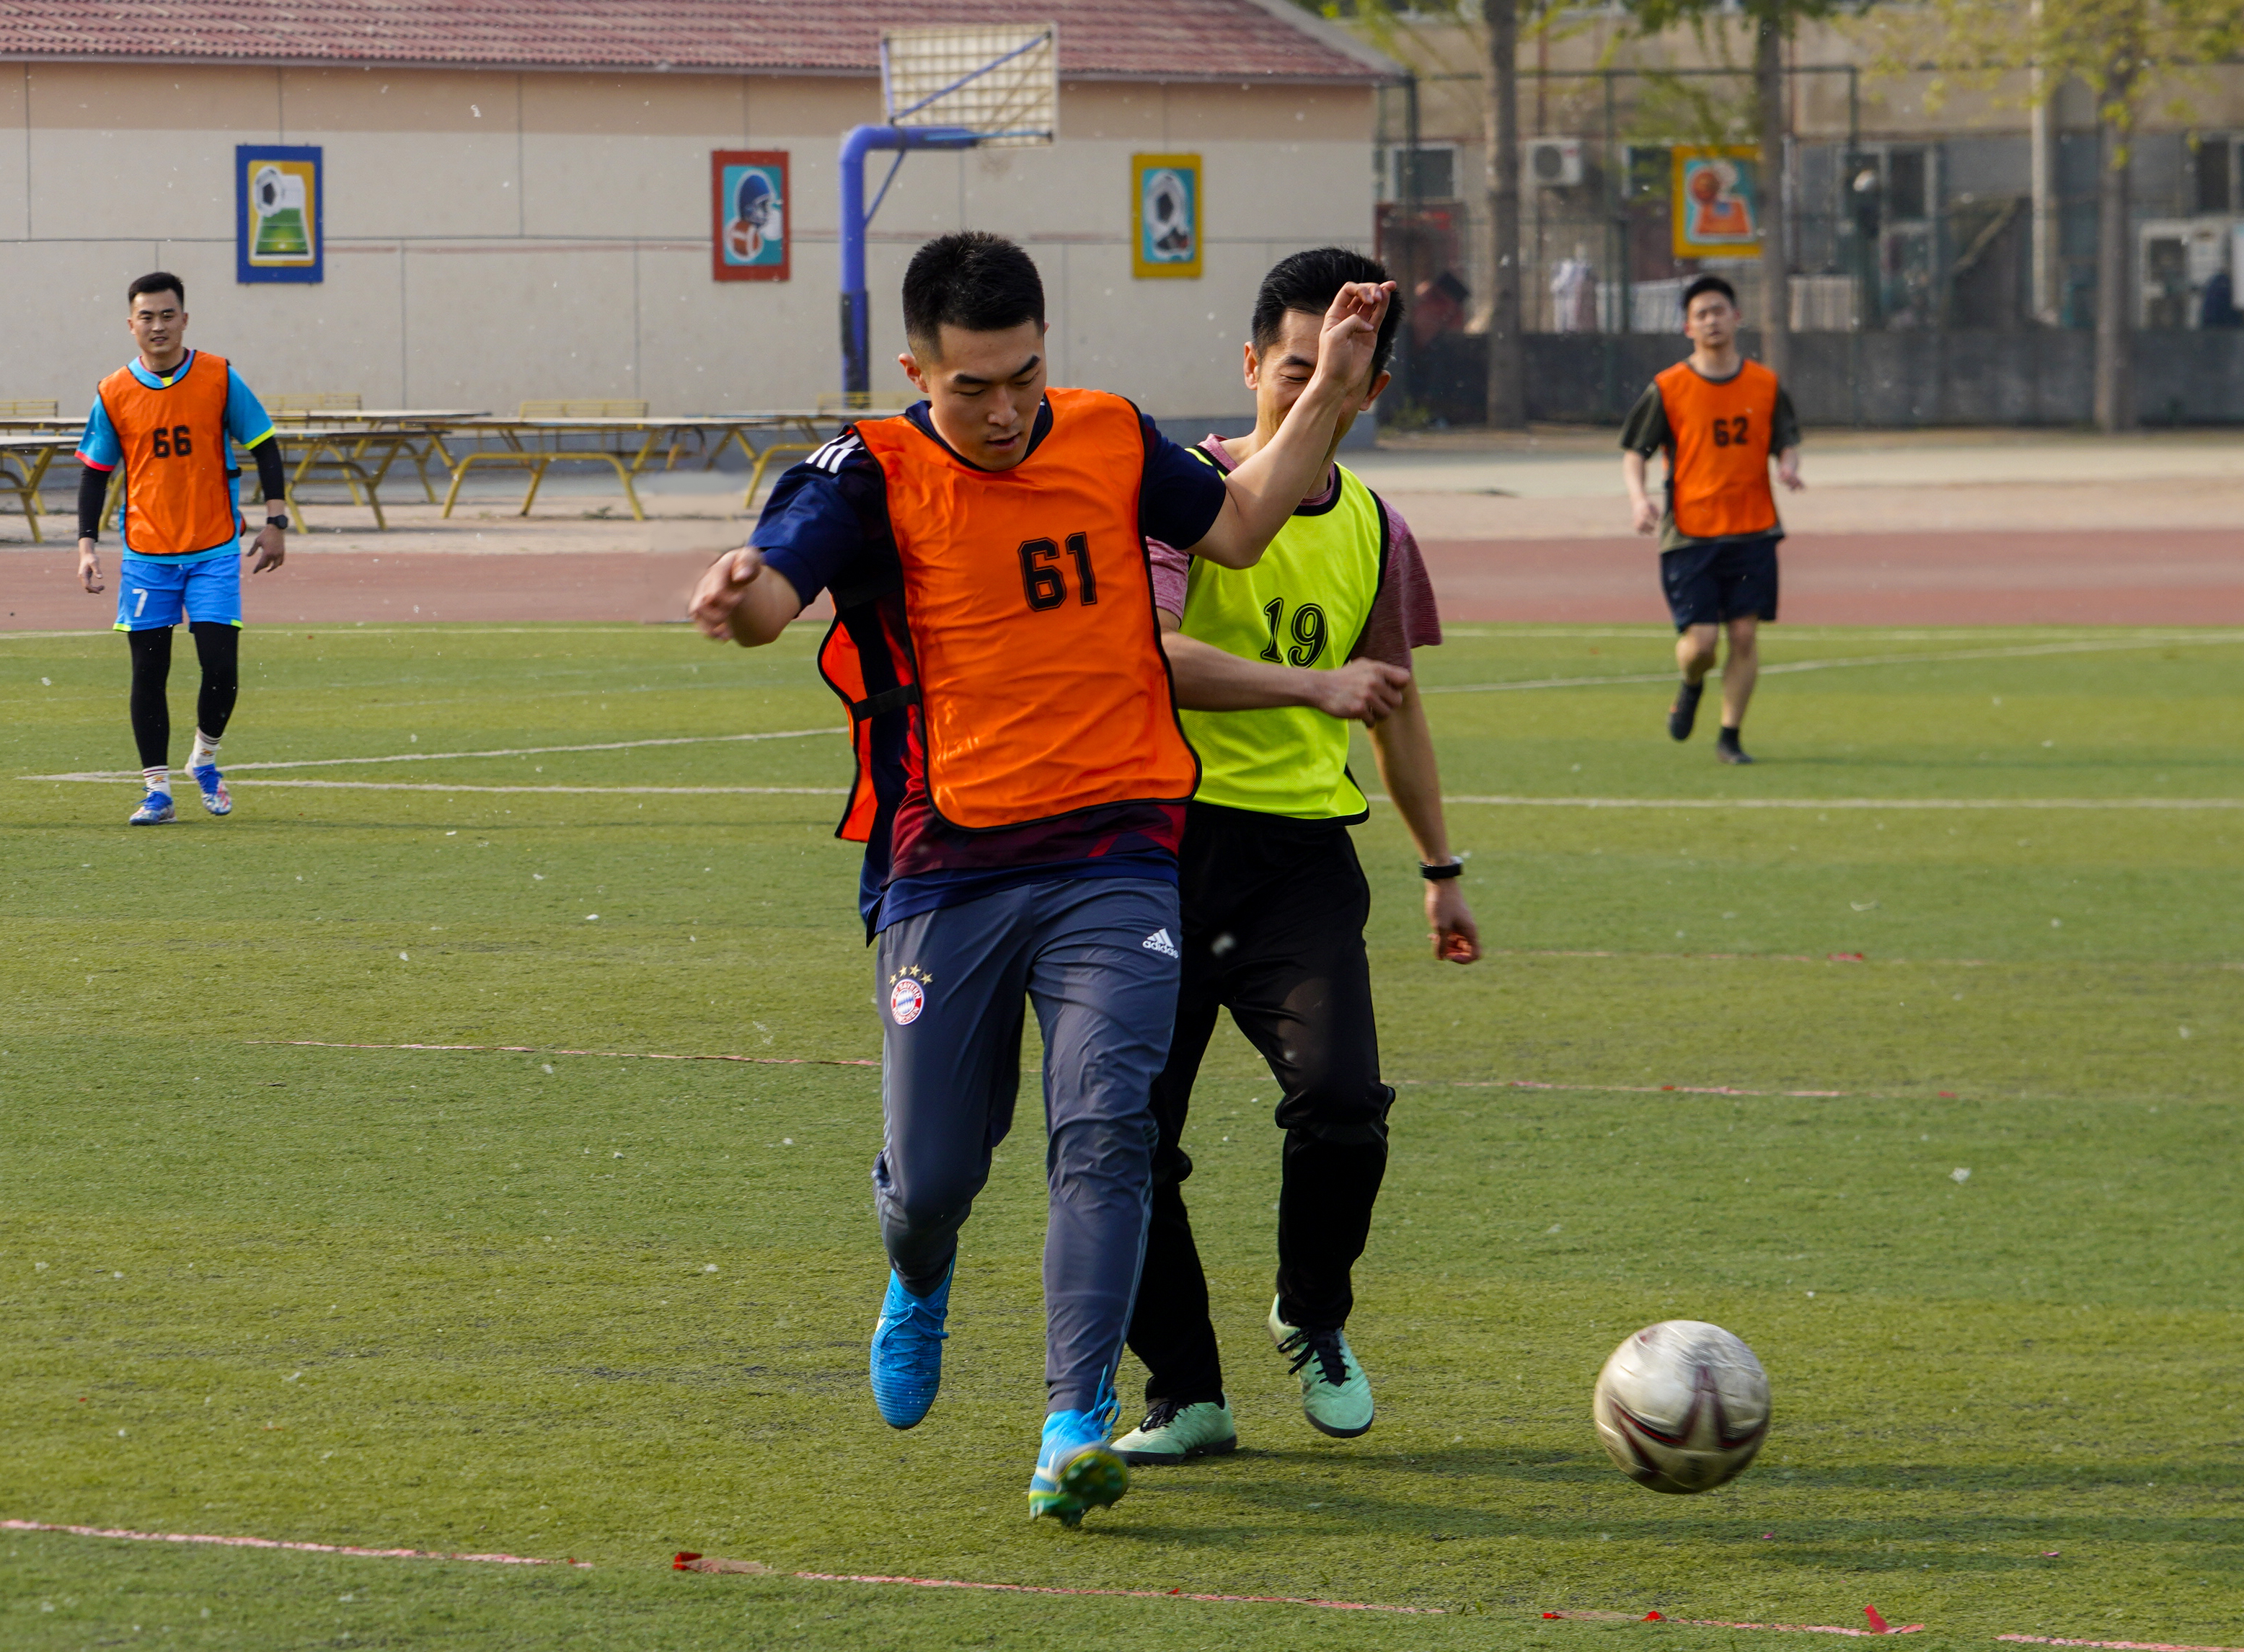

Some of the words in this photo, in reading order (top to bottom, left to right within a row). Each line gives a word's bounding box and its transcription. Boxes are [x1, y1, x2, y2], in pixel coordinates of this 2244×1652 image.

[153, 425, 192, 458] 66
[1713, 415, 1748, 448] 62
[1017, 531, 1097, 612] 61
[132, 588, 149, 617] 7
[1260, 597, 1328, 668] 19
[1142, 940, 1179, 959] adidas
